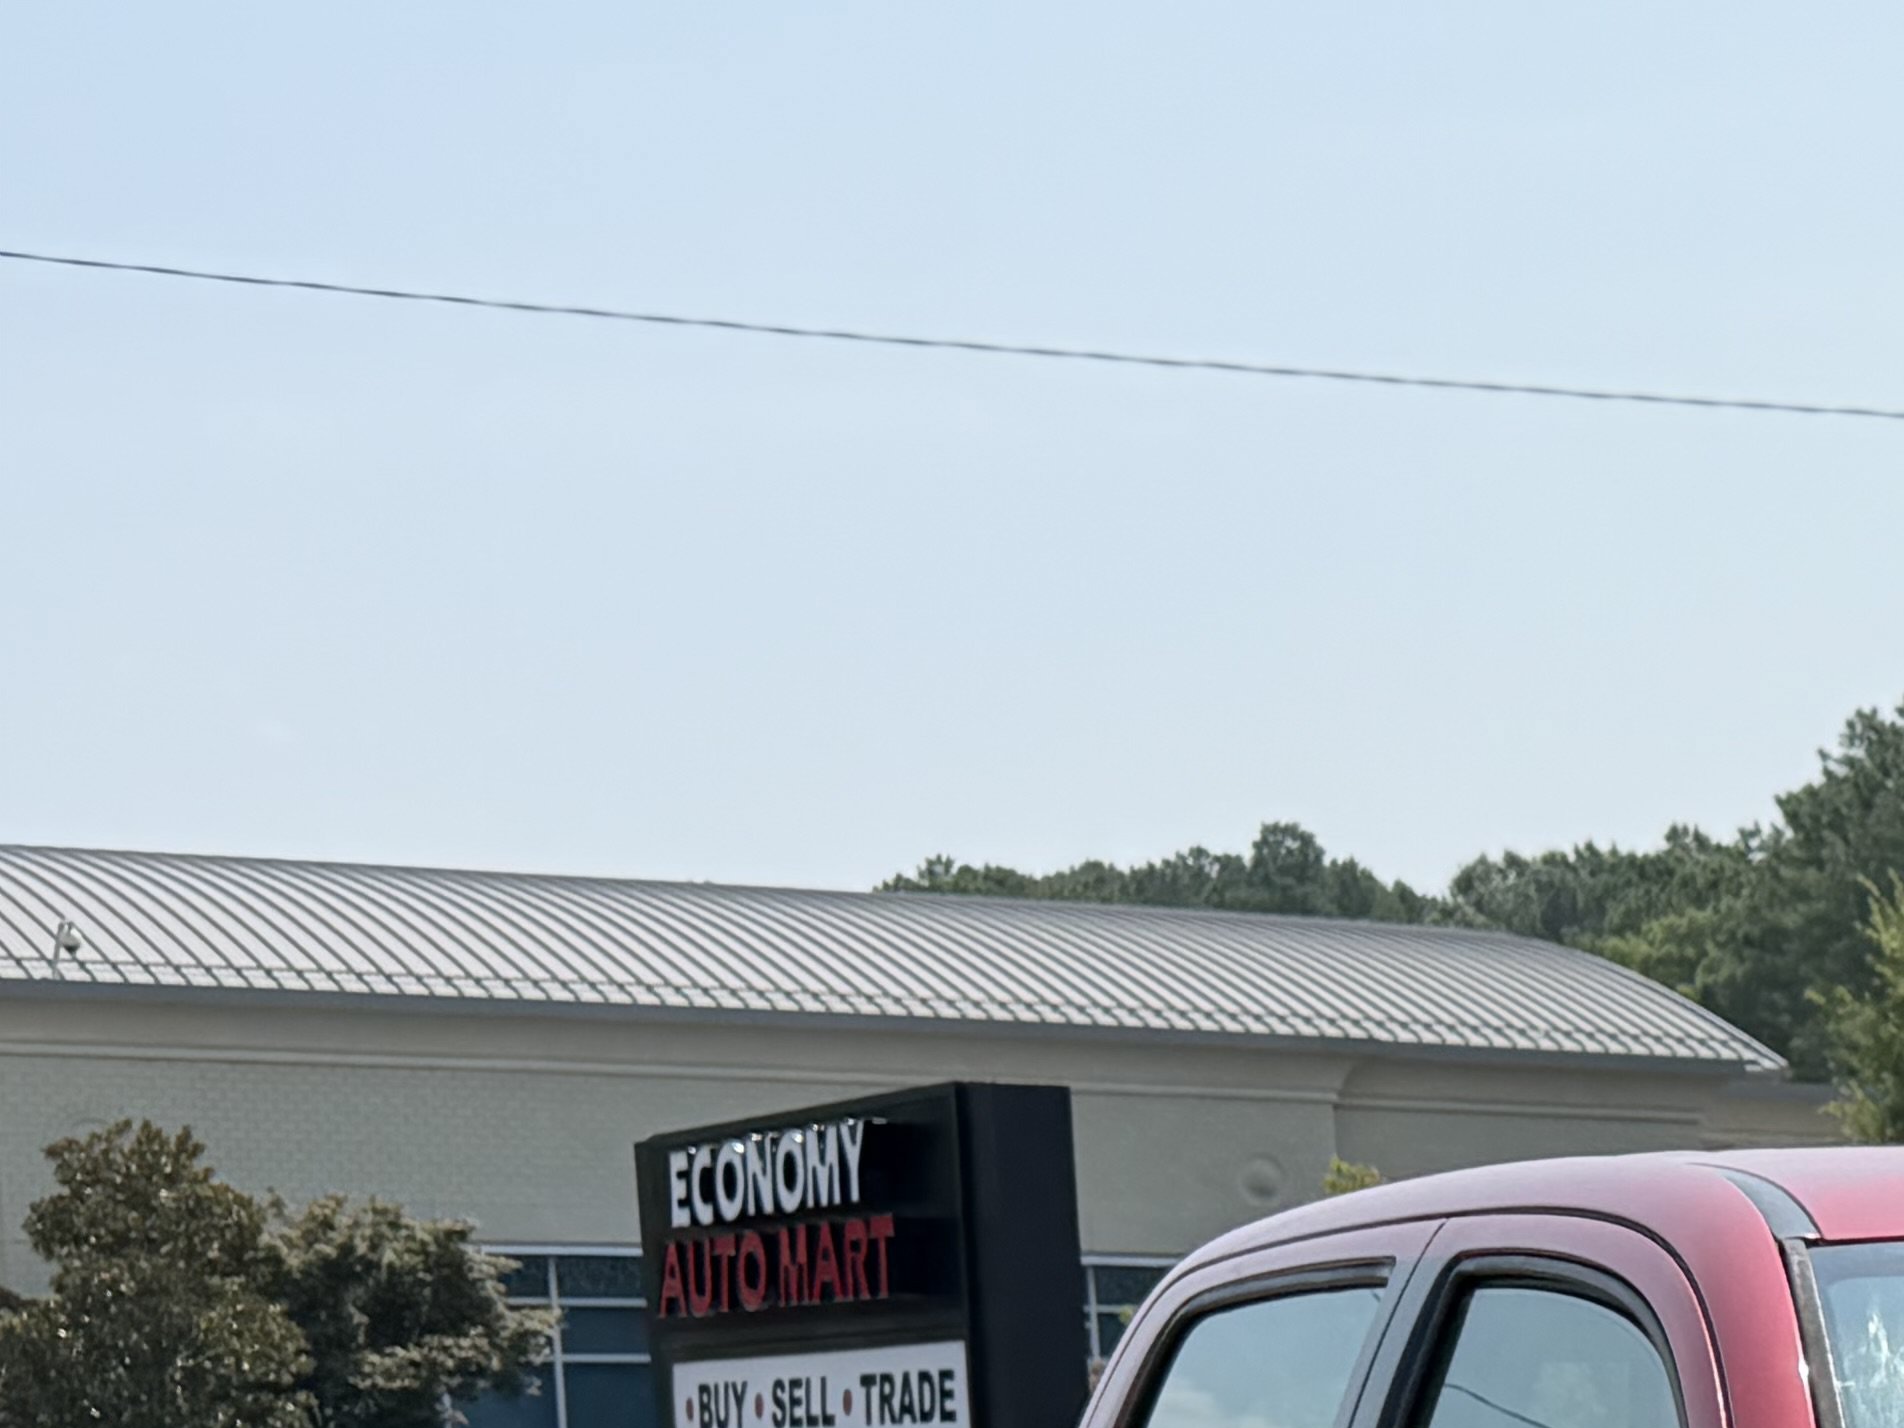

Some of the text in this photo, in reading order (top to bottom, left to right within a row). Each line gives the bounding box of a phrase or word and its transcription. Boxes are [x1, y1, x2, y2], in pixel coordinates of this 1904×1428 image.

[669, 1118, 865, 1228] ECONOMY
[659, 1214, 895, 1318] AUTO MART
[860, 1369, 957, 1426] TRADE
